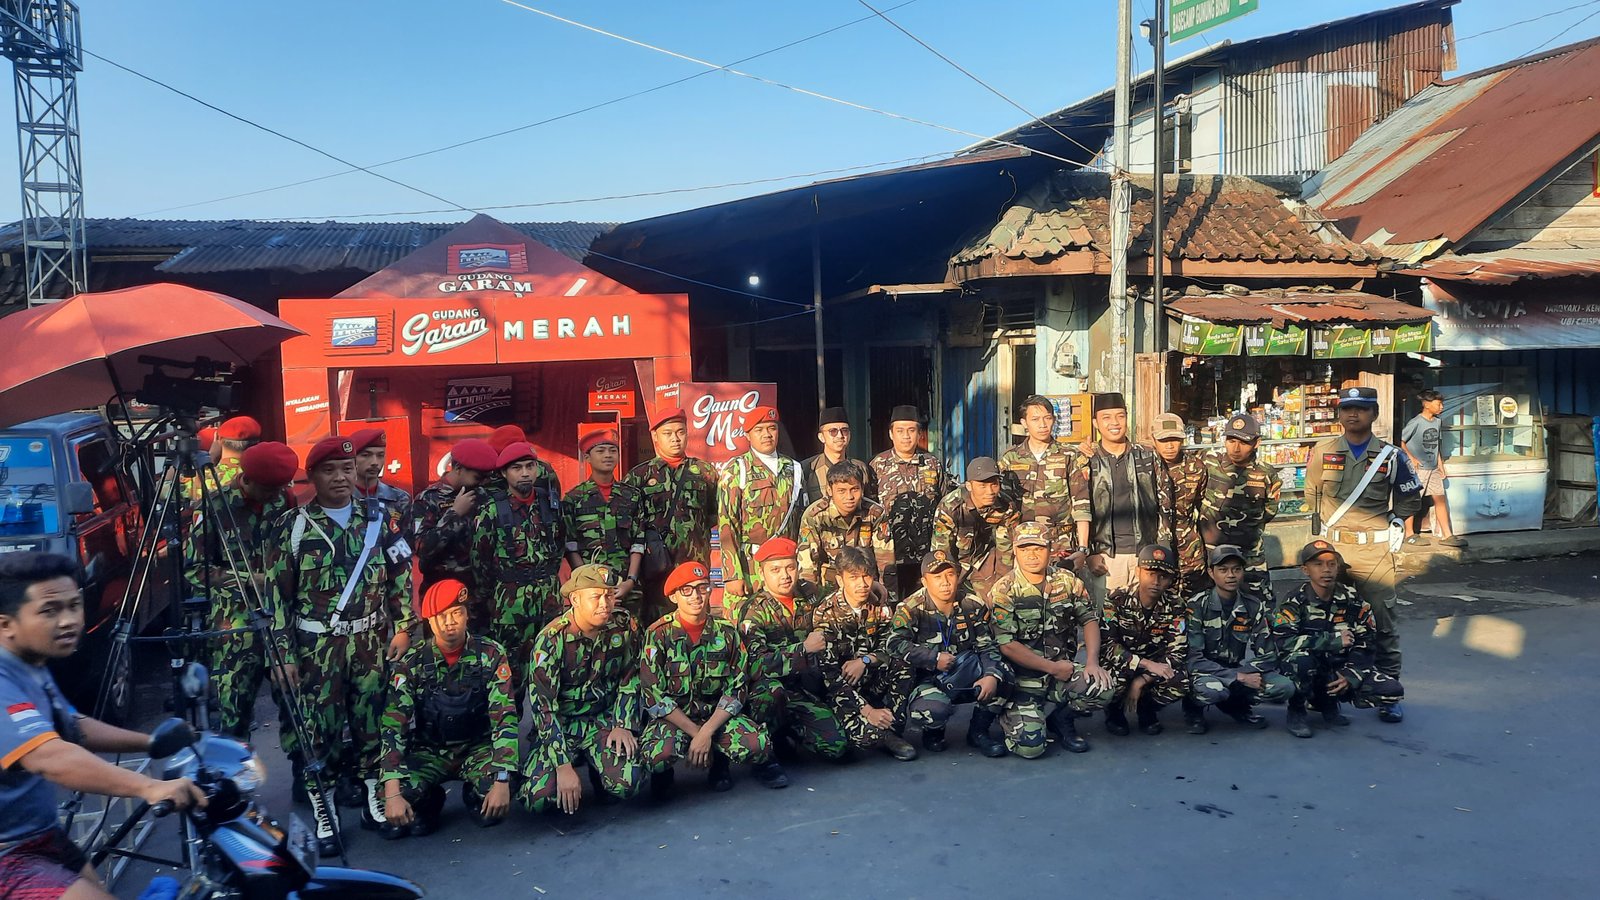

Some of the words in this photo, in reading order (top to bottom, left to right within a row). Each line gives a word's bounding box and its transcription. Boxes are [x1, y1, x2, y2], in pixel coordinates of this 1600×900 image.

[457, 273, 513, 281] GUDANG
[438, 279, 532, 293] GARAM
[432, 308, 479, 320] GUDANG
[401, 313, 490, 356] Garam
[503, 315, 631, 341] MERAH
[285, 395, 320, 406] NYALAKAN
